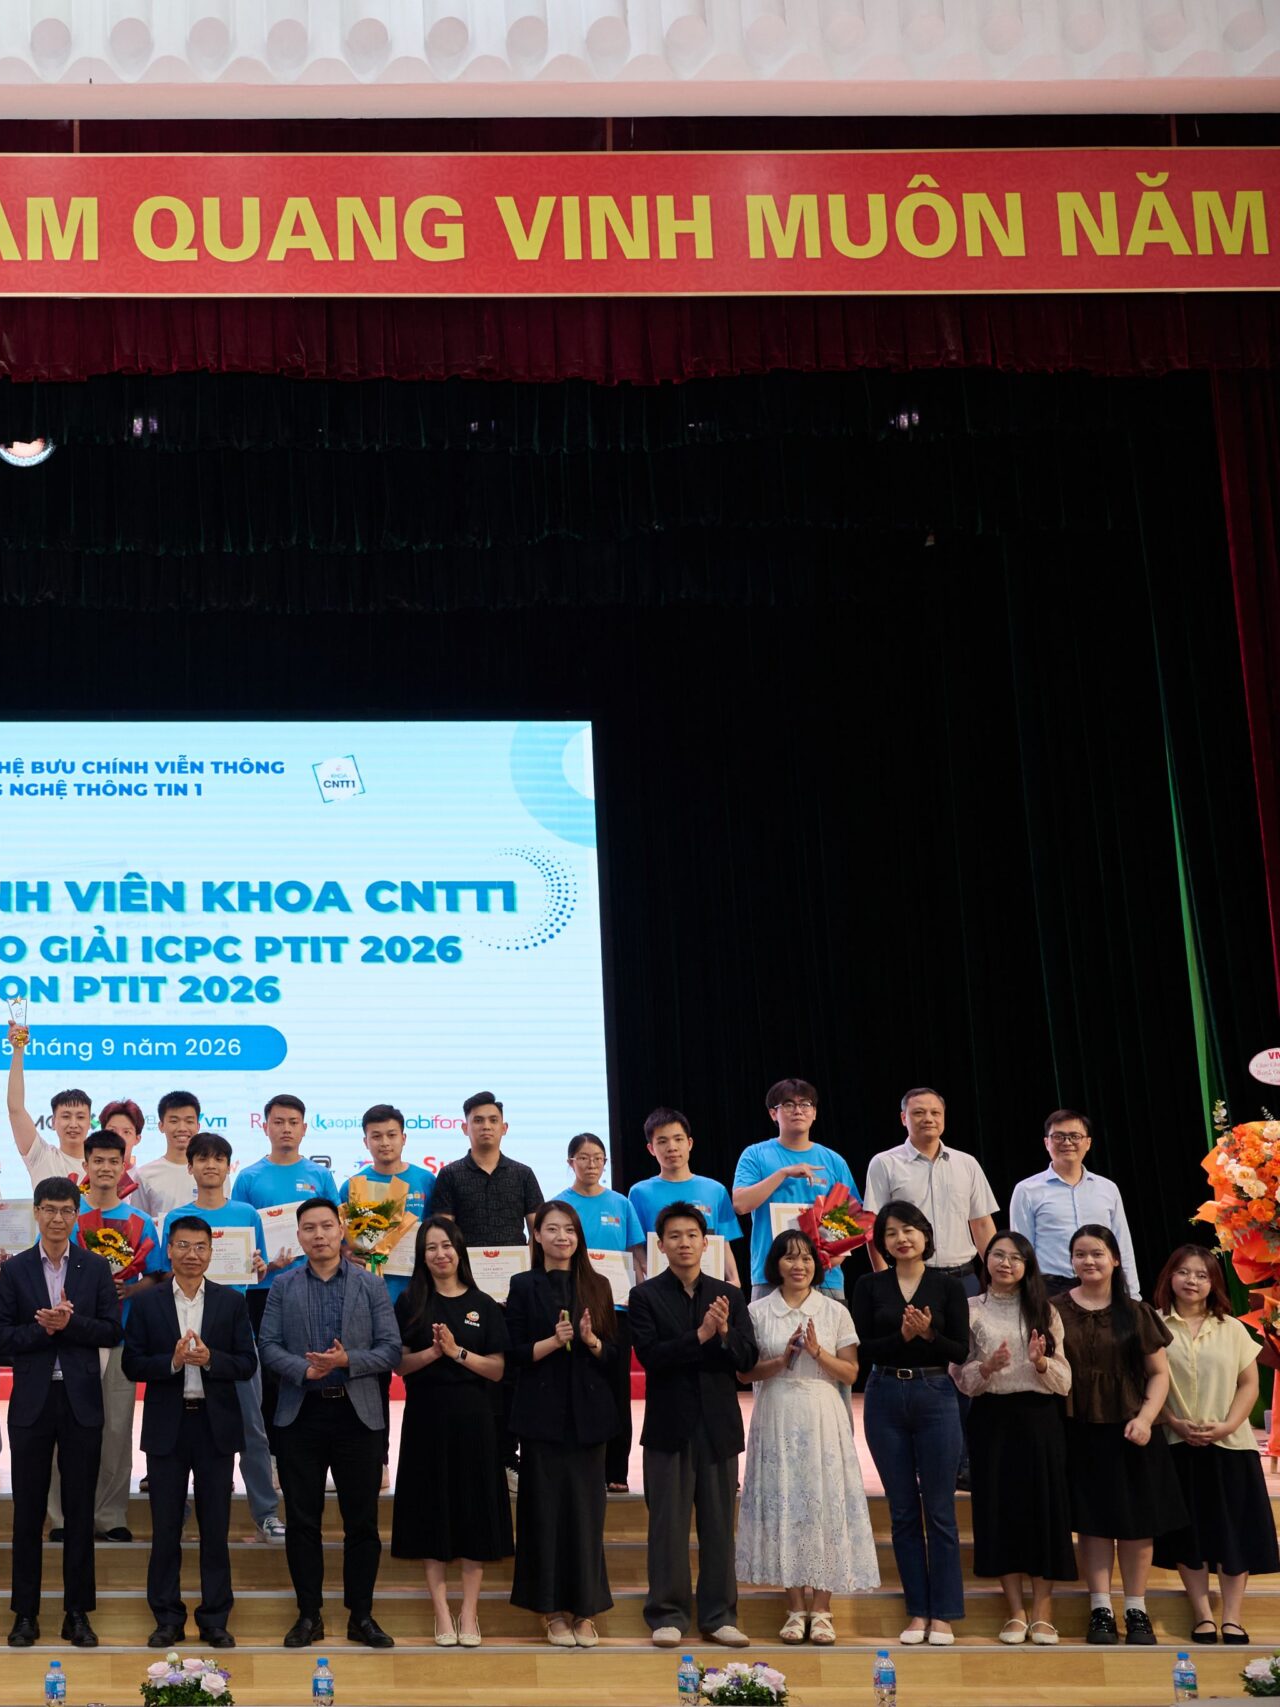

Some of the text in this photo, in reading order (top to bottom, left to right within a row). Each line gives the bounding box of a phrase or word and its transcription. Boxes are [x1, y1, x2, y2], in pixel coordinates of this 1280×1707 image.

[133, 195, 464, 263] QUANG
[495, 195, 713, 261] VINH
[746, 175, 1026, 259] MUÔN
[1057, 172, 1269, 256] NĂM
[32, 759, 75, 774] BƯU
[82, 758, 148, 774] CHÍNH
[155, 755, 204, 774] VIỄN
[211, 758, 284, 774] THÔNG
[10, 780, 67, 800] NGHỆ
[74, 780, 147, 797] THÔNG
[154, 784, 187, 797] TIN
[195, 784, 201, 797] 1
[323, 780, 355, 788] CNTT1
[64, 872, 186, 913] VIÊN
[202, 881, 352, 913] KHOA
[365, 880, 518, 913] CNTT1
[40, 925, 128, 963] GIẢI
[142, 936, 241, 963] ICPC
[255, 936, 349, 963] PTIT
[360, 936, 462, 963] 2026
[74, 976, 168, 1003] PTIT
[179, 976, 281, 1003] 2026
[102, 1039, 114, 1056] 9
[124, 1039, 177, 1056] năm
[186, 1039, 241, 1056] 2026
[204, 1117, 227, 1128] VTI
[405, 1114, 465, 1129] obifon
